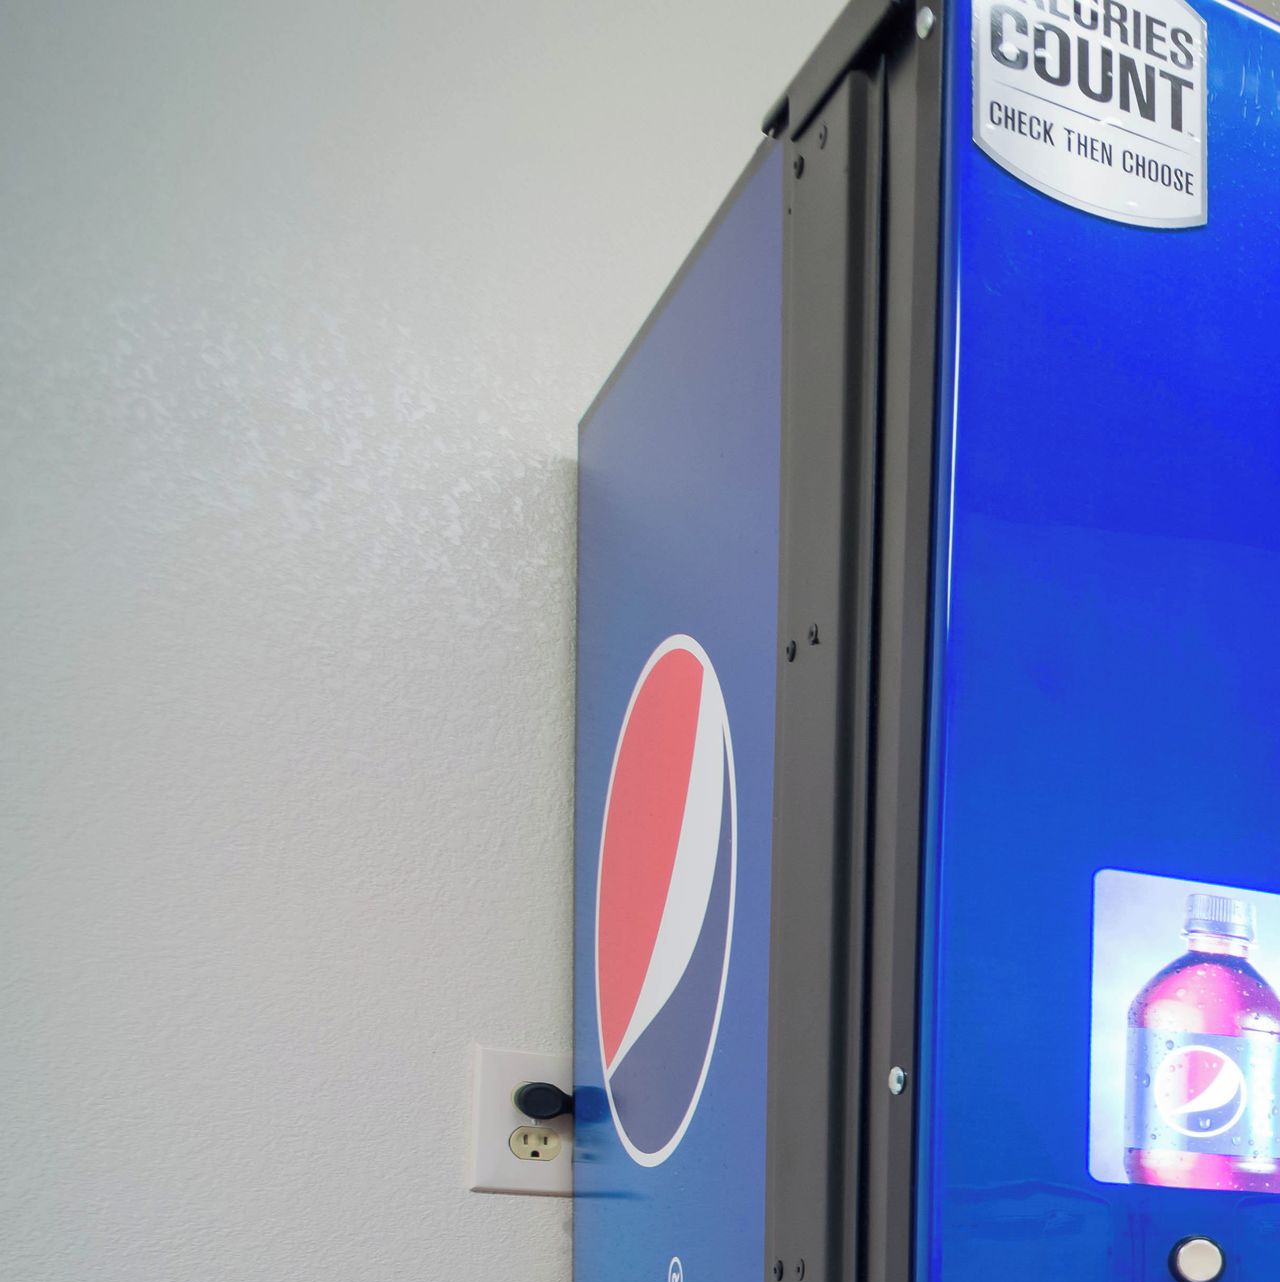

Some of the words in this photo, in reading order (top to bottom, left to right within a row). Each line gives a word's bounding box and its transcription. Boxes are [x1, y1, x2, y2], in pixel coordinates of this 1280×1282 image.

[990, 2, 1194, 134] COUNT
[1021, 0, 1194, 71] LORIES
[989, 100, 1055, 147] CHECK
[1064, 127, 1113, 167] THEN
[1122, 150, 1195, 196] CHOOSE
